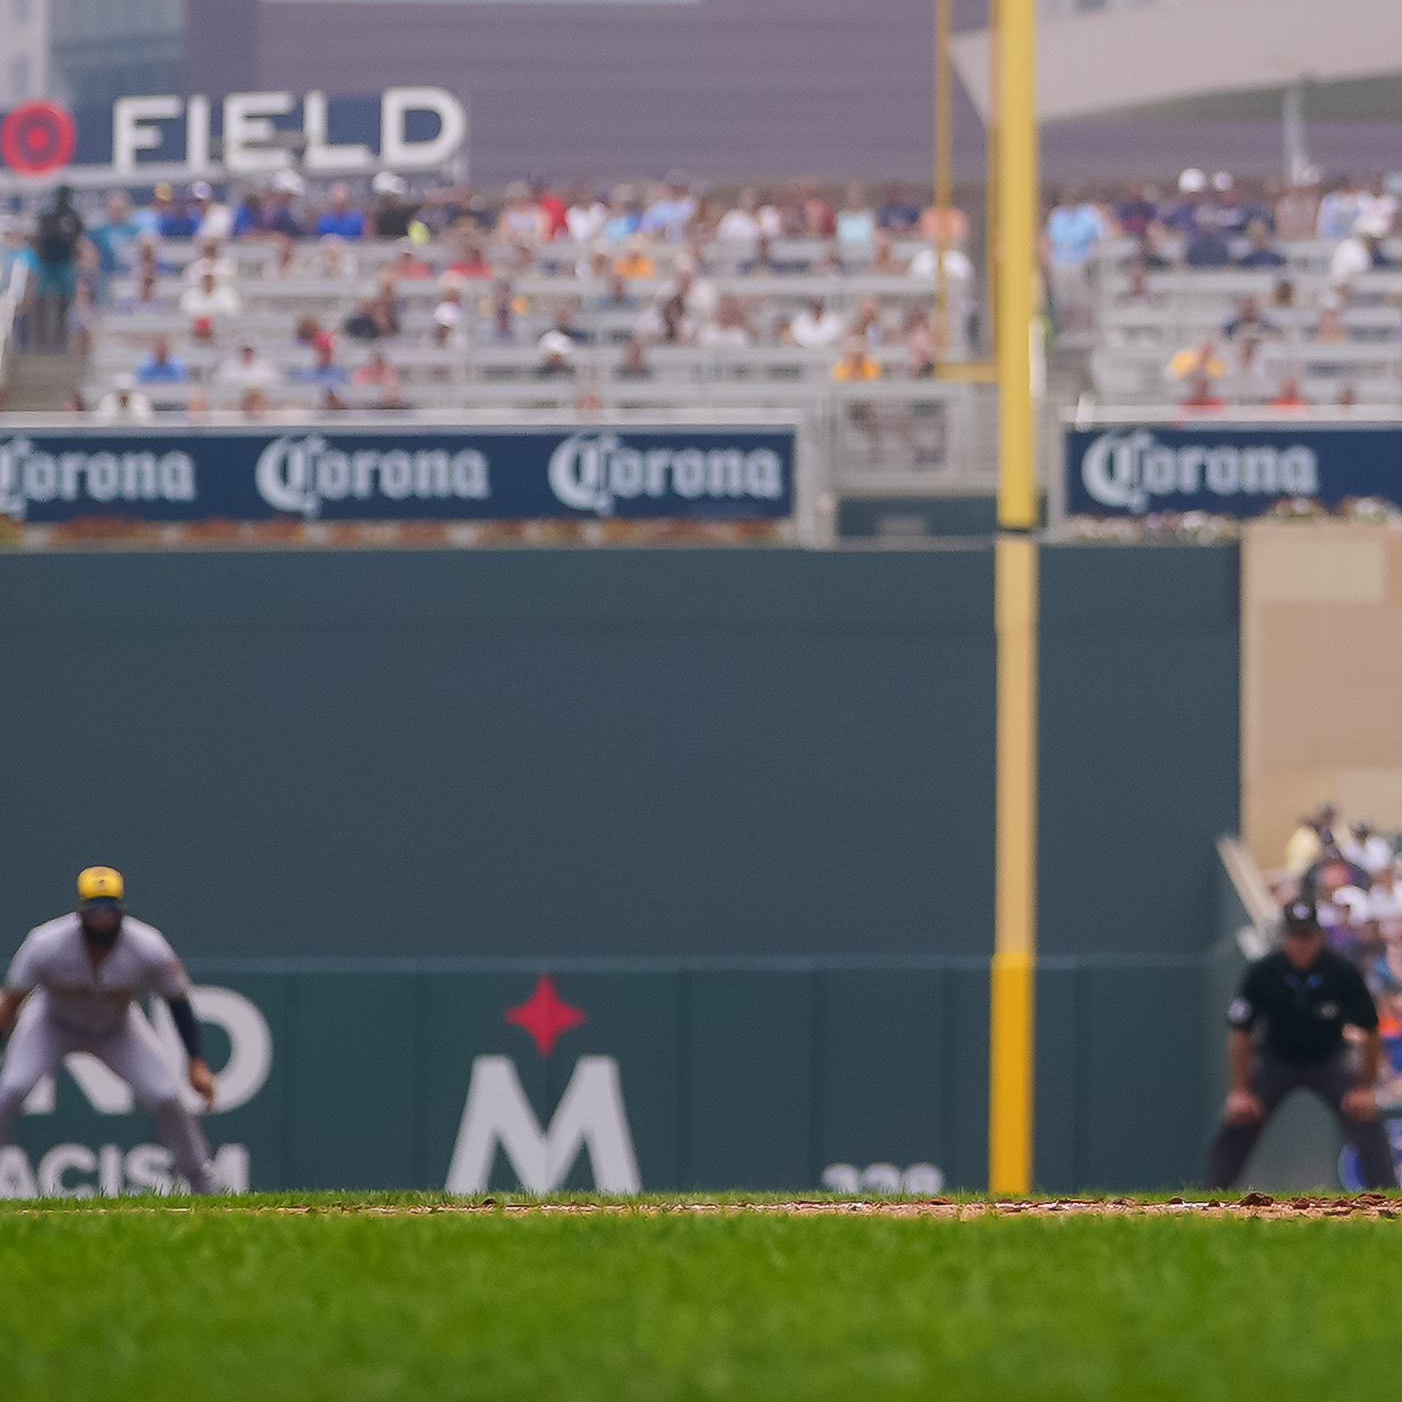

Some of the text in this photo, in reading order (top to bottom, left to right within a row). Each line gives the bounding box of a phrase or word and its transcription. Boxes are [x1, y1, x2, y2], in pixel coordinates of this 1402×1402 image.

[112, 86, 467, 176] FIELD
[255, 435, 490, 518] Corona
[548, 432, 783, 516] Corona
[1081, 429, 1318, 512] Corona
